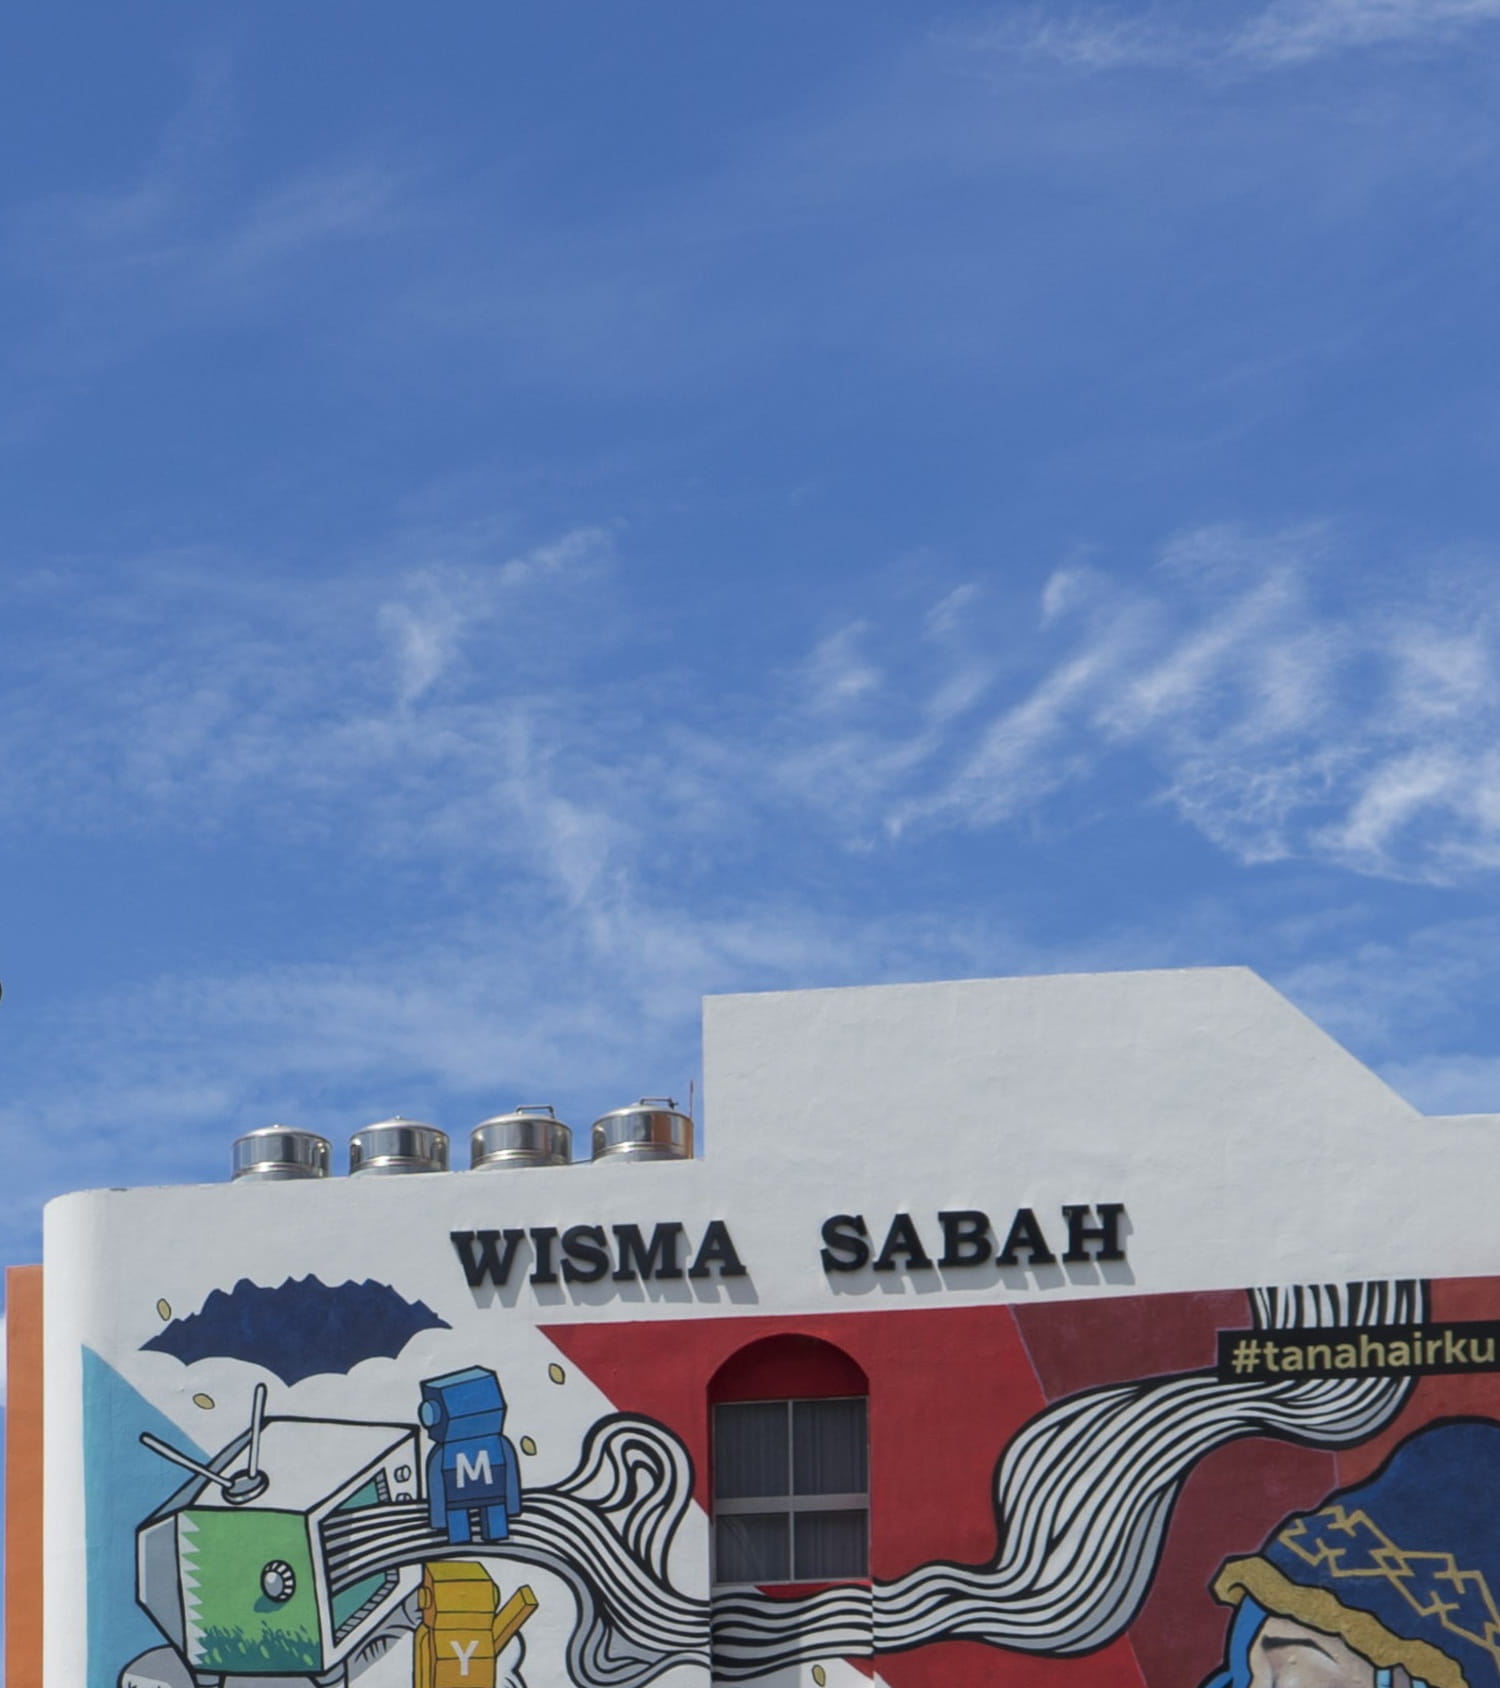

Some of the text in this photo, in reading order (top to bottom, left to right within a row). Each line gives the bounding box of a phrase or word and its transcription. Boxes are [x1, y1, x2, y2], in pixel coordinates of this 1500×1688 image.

[449, 1203, 1128, 1288] WISMA SABAH
[1230, 1332, 1498, 1377] #tanahairku
[456, 1448, 494, 1491] M
[449, 1640, 480, 1678] Y
